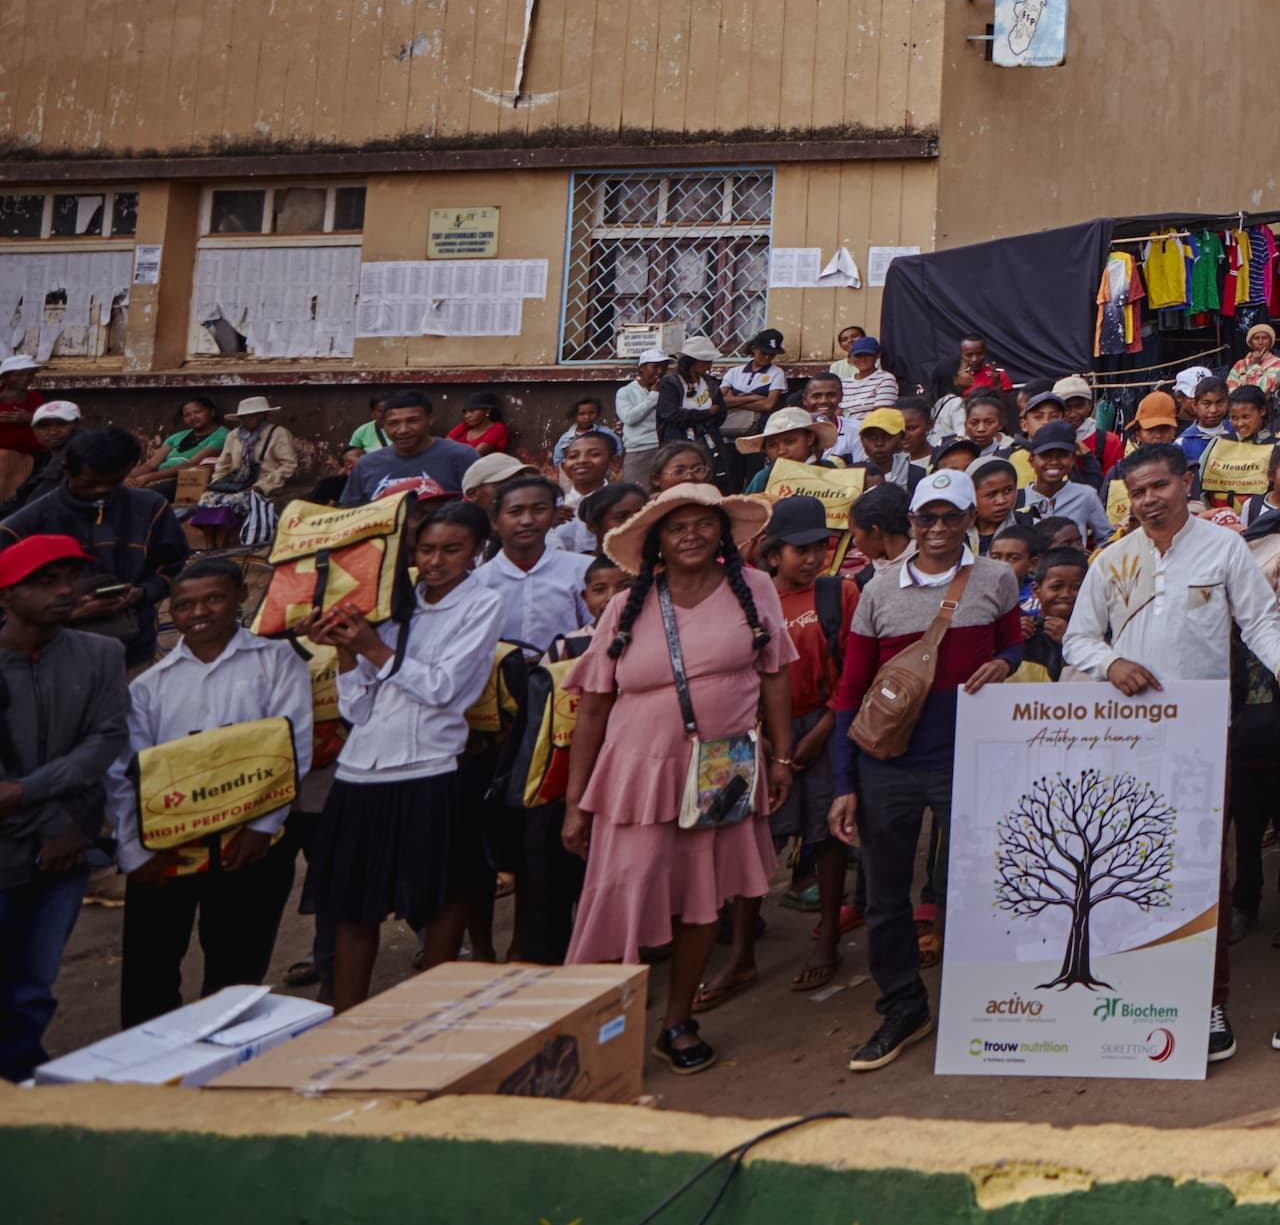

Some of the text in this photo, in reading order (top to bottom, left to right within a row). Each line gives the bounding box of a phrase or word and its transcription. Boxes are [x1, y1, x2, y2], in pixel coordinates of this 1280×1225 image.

[1222, 462, 1260, 472] Hendrix
[794, 486, 848, 500] Hendrix
[1012, 699, 1178, 723] Mikolo kilonga
[192, 767, 274, 803] Hendrix
[192, 785, 294, 829] PERFORMANC
[985, 996, 1043, 1016] activo
[1121, 1003, 1178, 1017] Biochem
[984, 1040, 1069, 1054] trouw nutrition
[1101, 1043, 1159, 1055] SKRETTING
